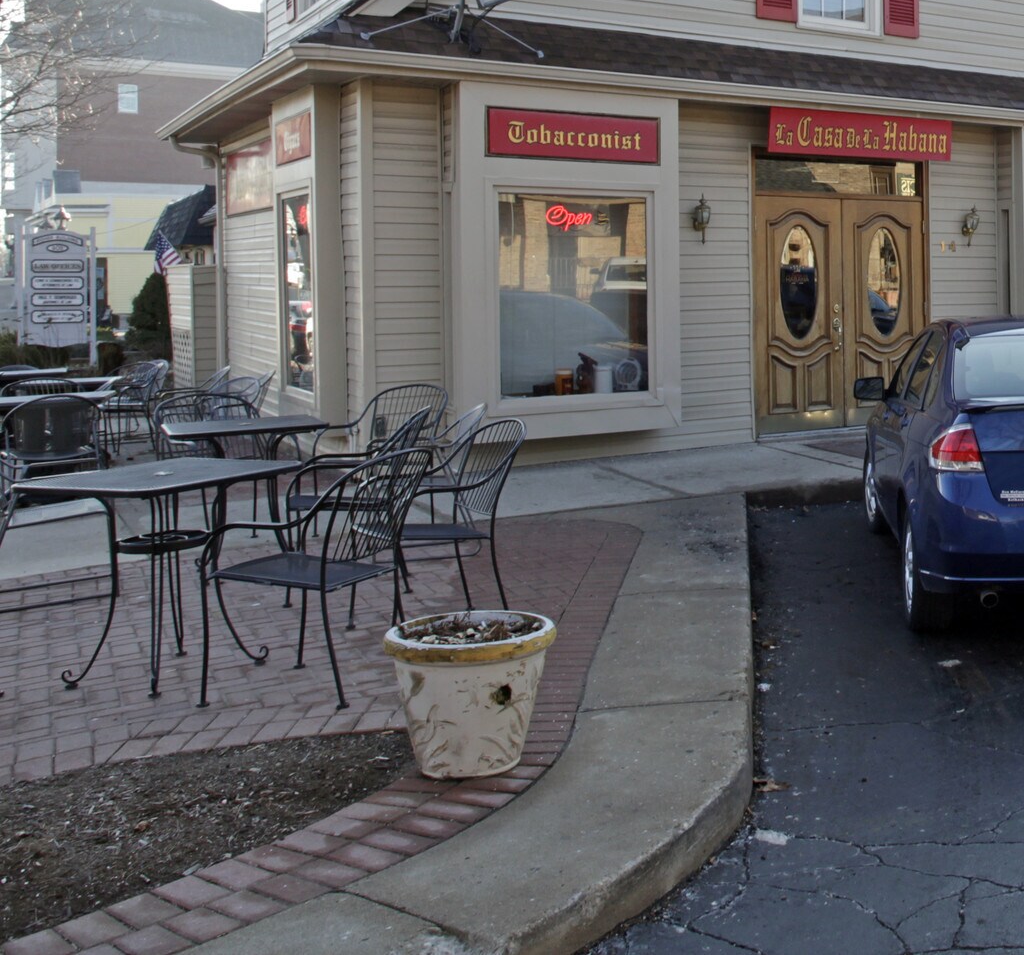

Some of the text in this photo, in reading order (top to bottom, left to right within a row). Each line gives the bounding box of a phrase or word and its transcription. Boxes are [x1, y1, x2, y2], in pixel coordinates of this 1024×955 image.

[507, 120, 642, 152] Tobacconist
[775, 124, 794, 146] La
[797, 116, 845, 149] Casa
[863, 129, 880, 150] La
[882, 121, 948, 155] Habana
[545, 204, 593, 232] Open
